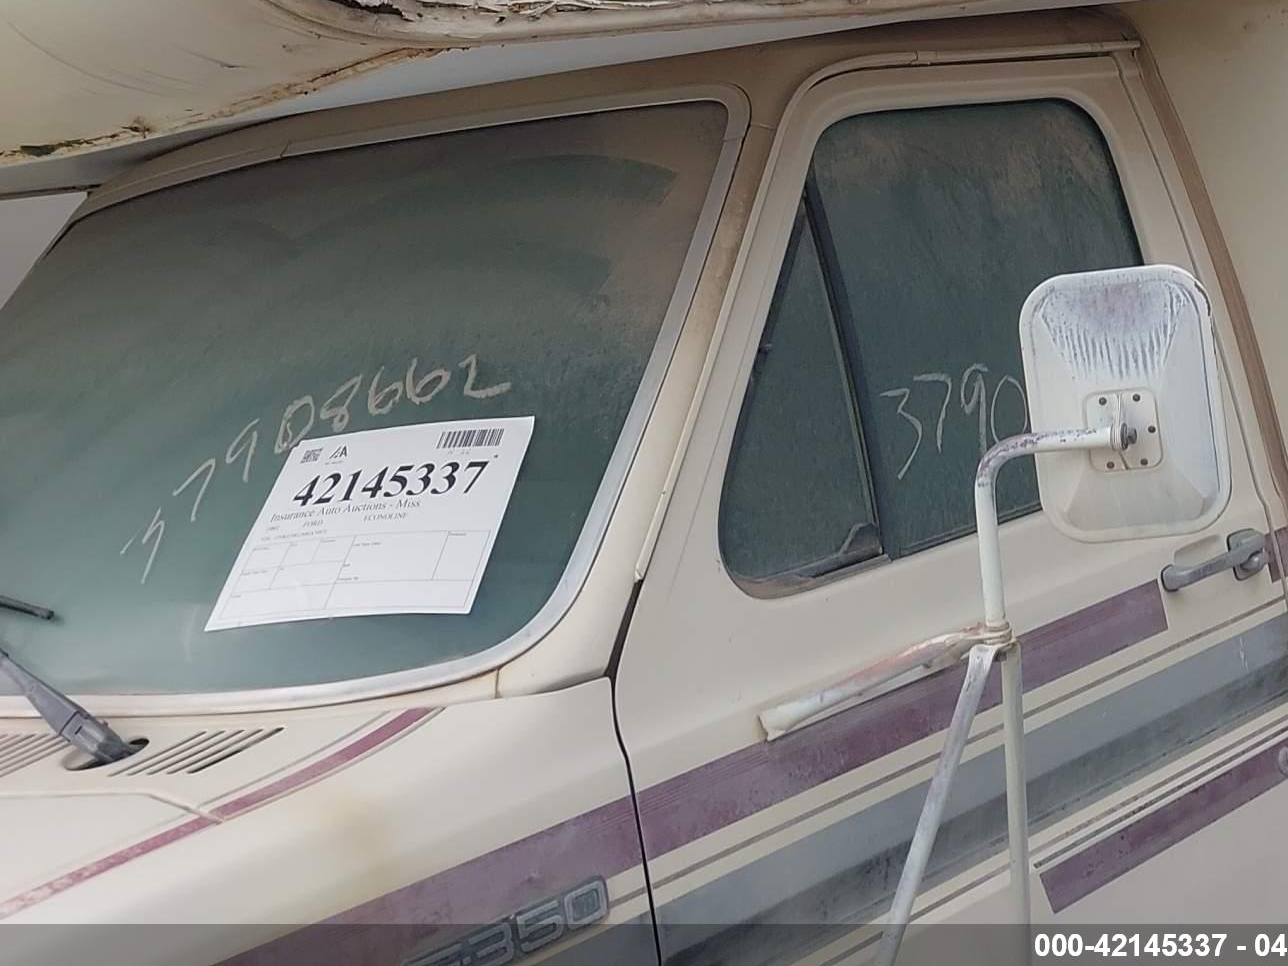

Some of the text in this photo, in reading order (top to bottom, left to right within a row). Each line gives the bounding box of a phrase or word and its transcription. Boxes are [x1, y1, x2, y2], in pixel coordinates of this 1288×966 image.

[292, 460, 490, 506] 42145337
[270, 508, 315, 523] Insurance
[316, 506, 340, 516] Auto
[342, 502, 387, 514] Auctions
